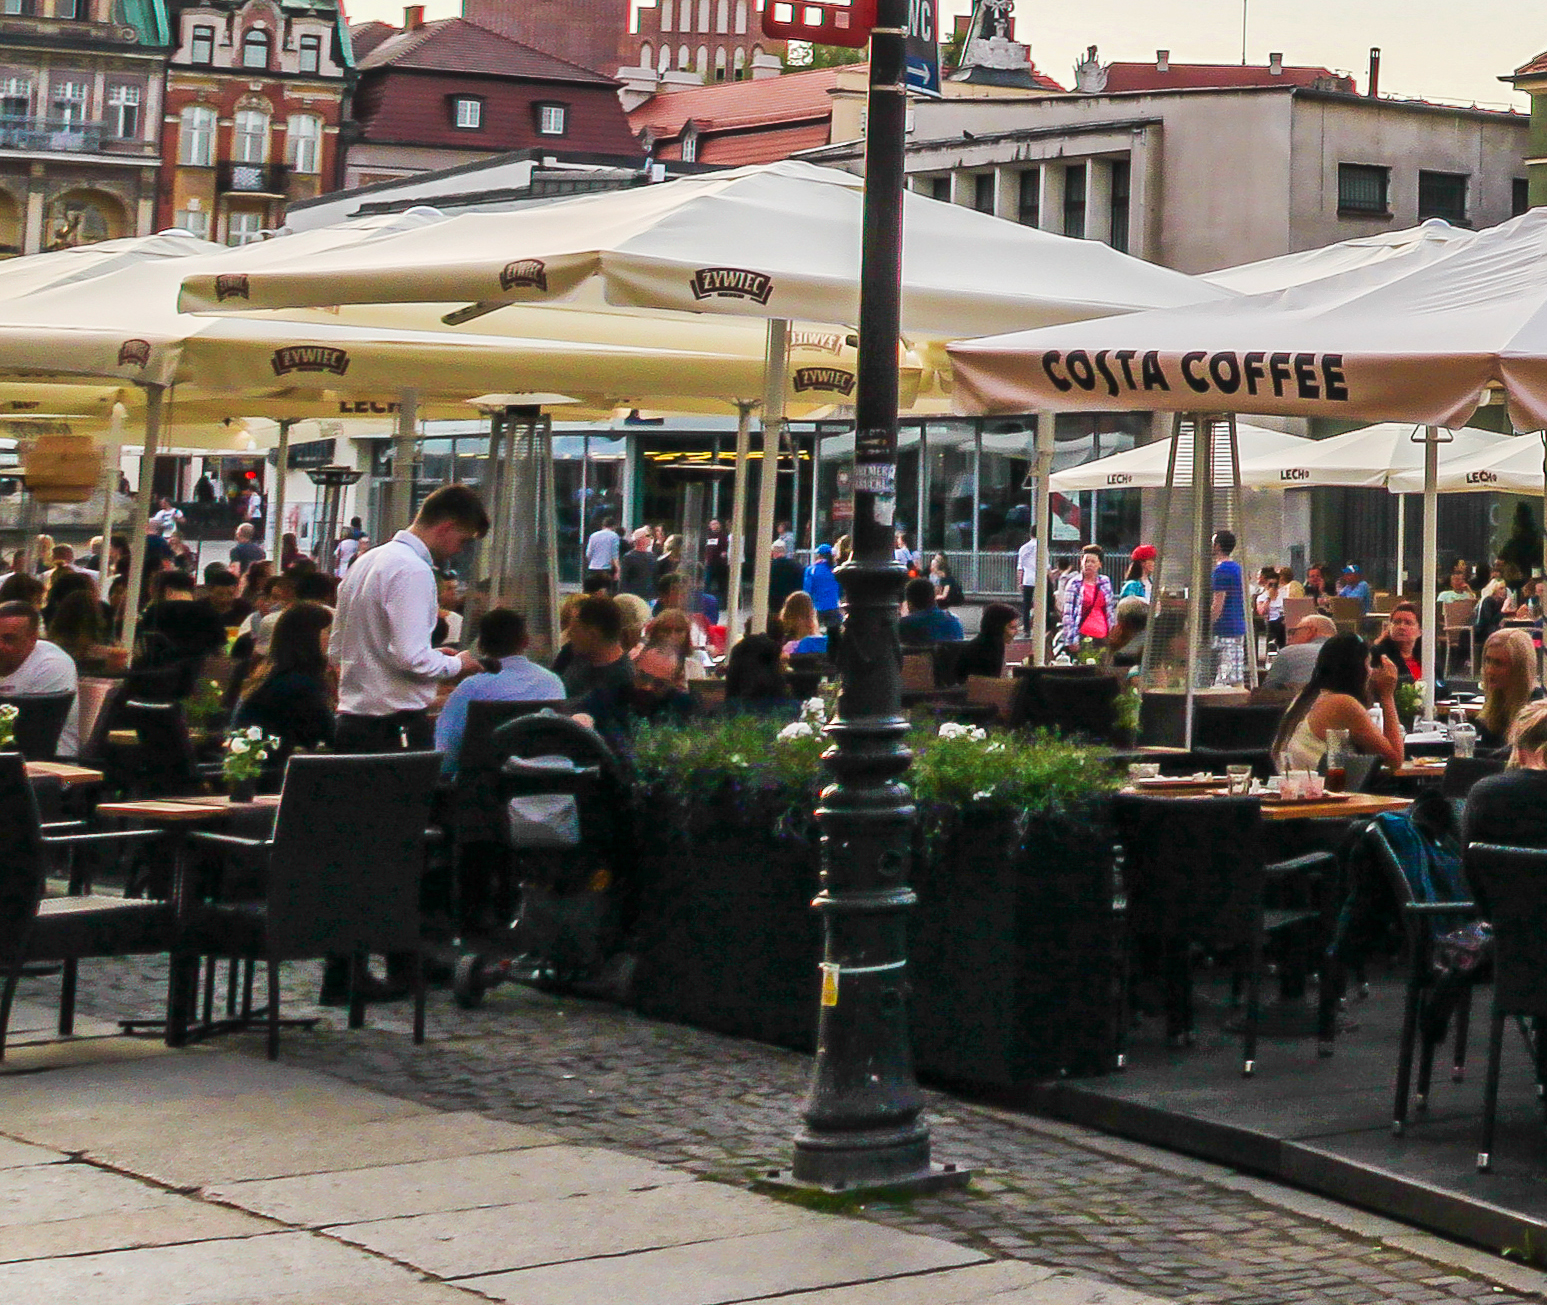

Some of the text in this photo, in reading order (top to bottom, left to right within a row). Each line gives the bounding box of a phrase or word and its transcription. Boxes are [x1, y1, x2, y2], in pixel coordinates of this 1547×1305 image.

[702, 269, 765, 294] ŻYWIEC
[801, 368, 850, 387] ŻYWIEC
[1042, 350, 1349, 401] COSTA COFFEE
[1107, 474, 1127, 484] LECH
[1280, 469, 1304, 480] LECH
[1466, 471, 1491, 483] LECH
